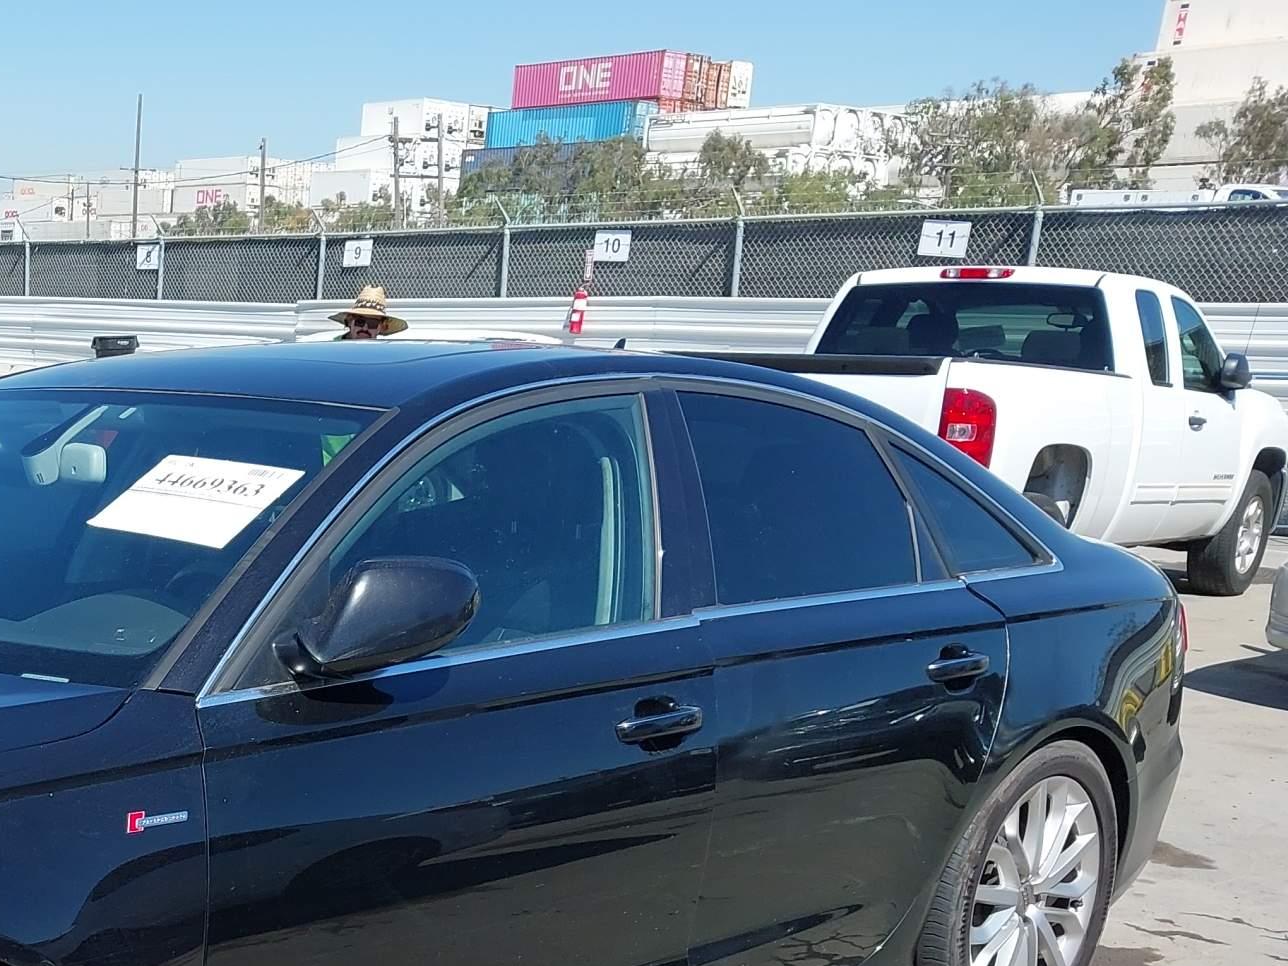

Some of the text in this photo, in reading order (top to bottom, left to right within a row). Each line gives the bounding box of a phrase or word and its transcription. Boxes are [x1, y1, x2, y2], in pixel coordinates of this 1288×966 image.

[559, 60, 613, 92] ONE
[196, 188, 222, 204] ONE
[603, 238, 621, 254] 10
[936, 229, 956, 248] 11
[145, 251, 152, 264] 8
[354, 246, 362, 260] 9
[155, 472, 265, 496] 44669363
